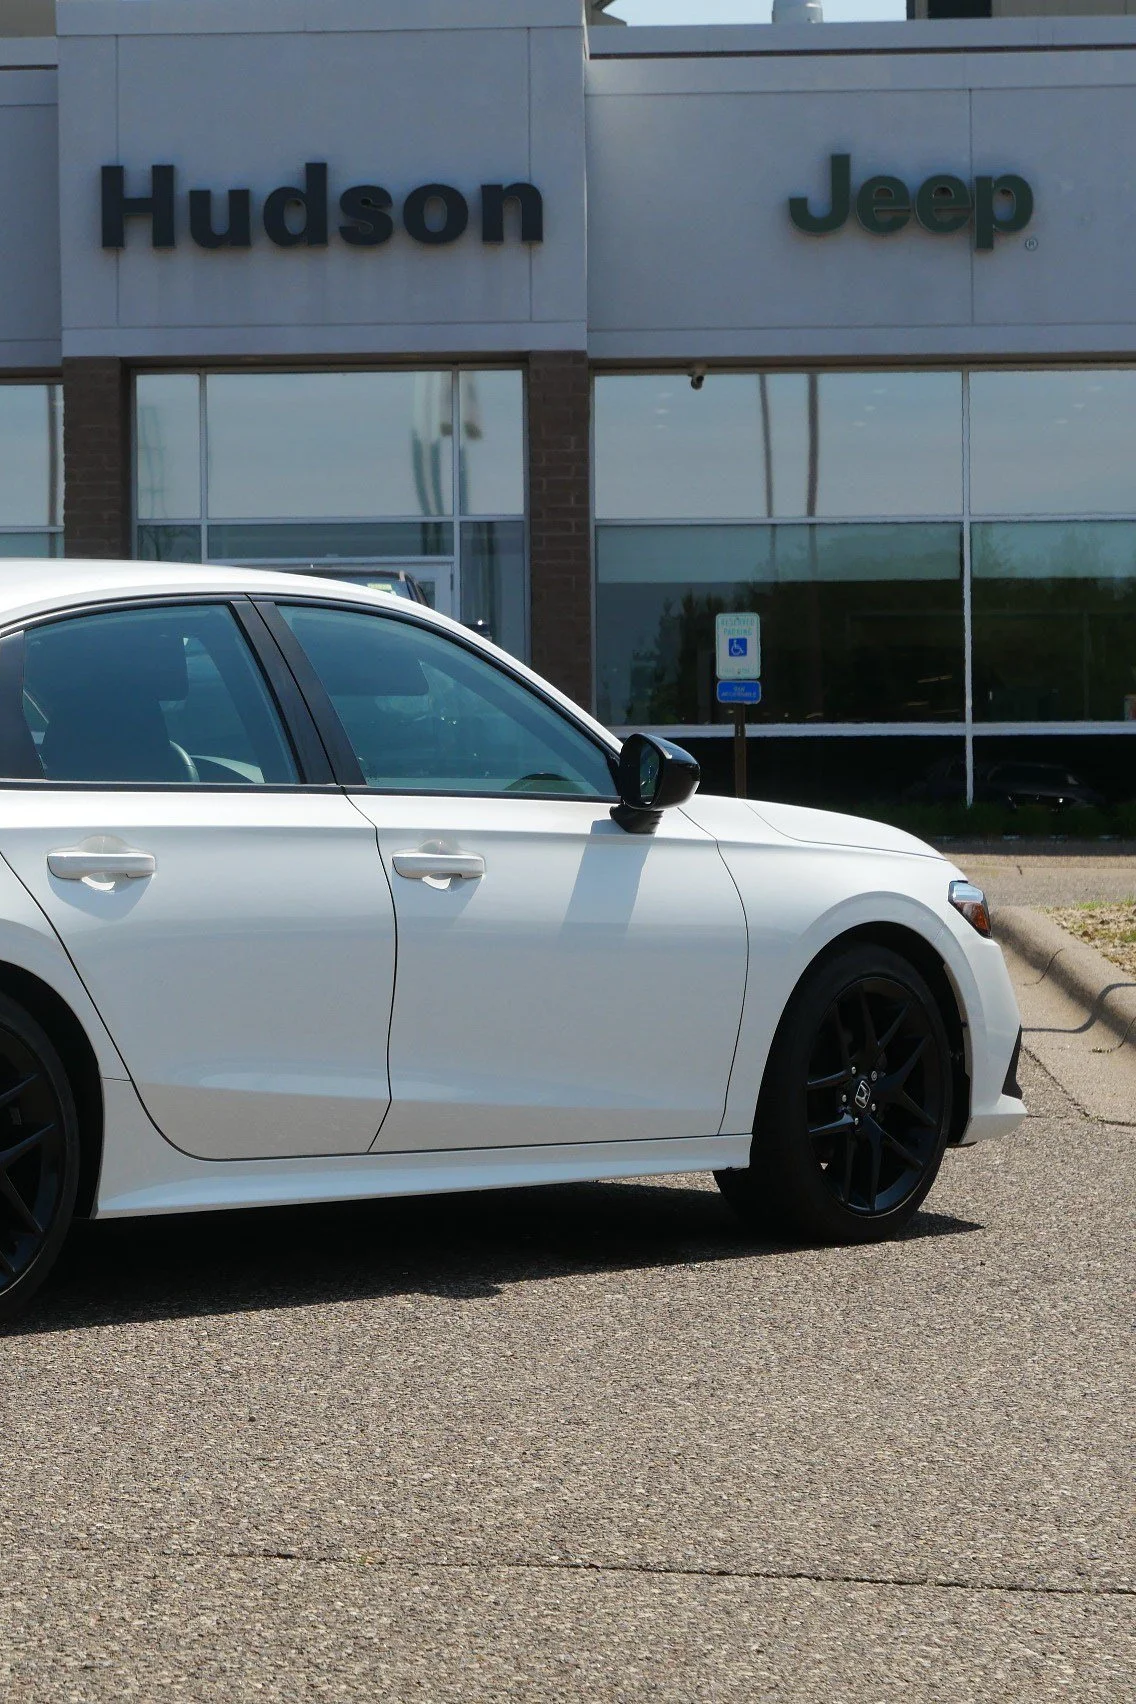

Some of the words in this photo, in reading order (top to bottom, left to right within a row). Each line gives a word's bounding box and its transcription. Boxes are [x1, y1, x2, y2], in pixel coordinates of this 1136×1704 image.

[101, 162, 544, 249] Hudson
[788, 154, 1034, 250] Jeep
[723, 627, 752, 636] PARKING
